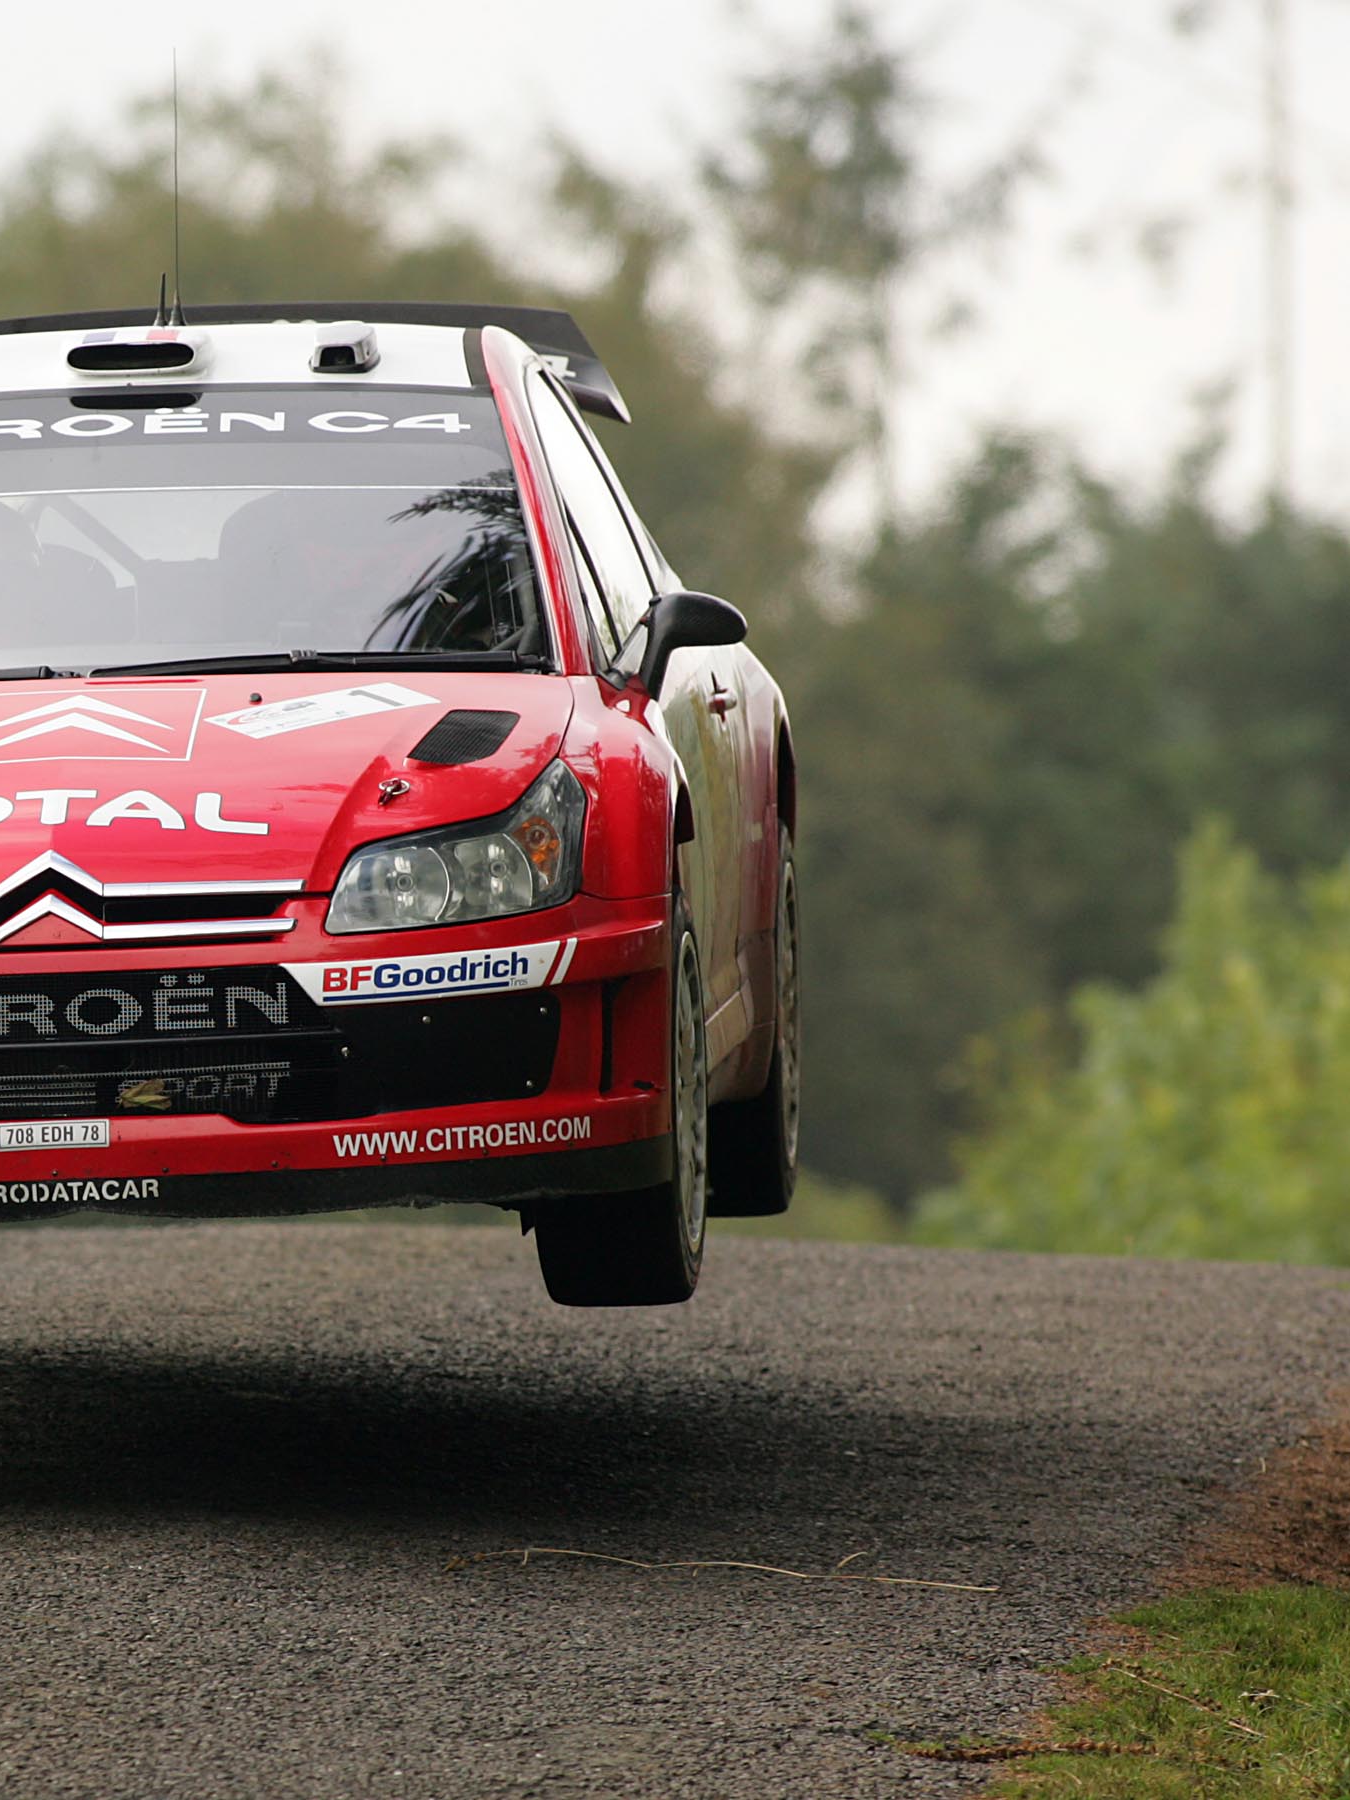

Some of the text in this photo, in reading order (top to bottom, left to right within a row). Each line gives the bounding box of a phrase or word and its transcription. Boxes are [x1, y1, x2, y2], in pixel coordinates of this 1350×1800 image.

[307, 411, 472, 434] C4
[348, 689, 405, 707] 1
[322, 951, 529, 993] BFGoodrich
[6, 1124, 100, 1145] 708 EDH 78
[332, 1115, 593, 1158] WWW.CITROEN.COM
